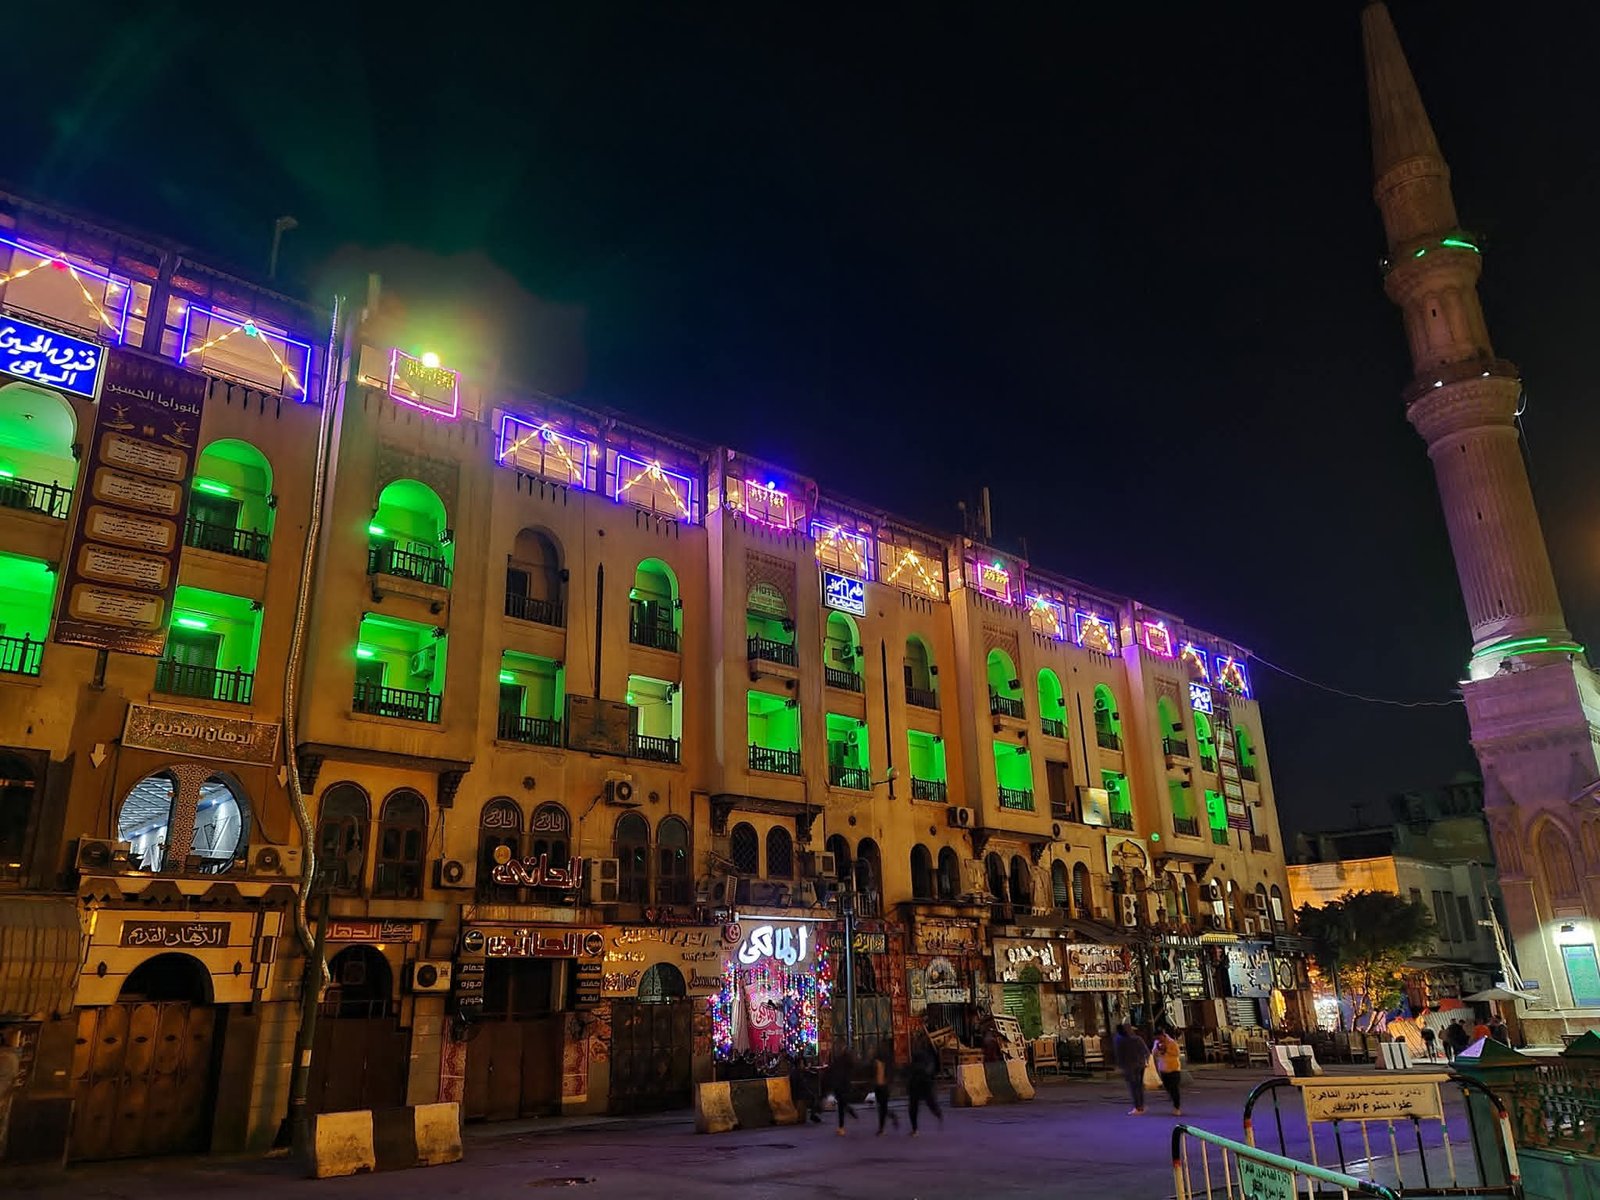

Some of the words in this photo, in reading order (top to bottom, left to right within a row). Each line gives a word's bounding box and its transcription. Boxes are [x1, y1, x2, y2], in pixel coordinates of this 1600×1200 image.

[106, 382, 154, 401] الحسين
[158, 393, 200, 417] بانوراما
[151, 721, 203, 739] القديم
[205, 727, 255, 745] الدهان
[128, 927, 166, 945] القديم
[1362, 1102, 1390, 1113] ممنوع
[1392, 1100, 1413, 1110] عفوا
